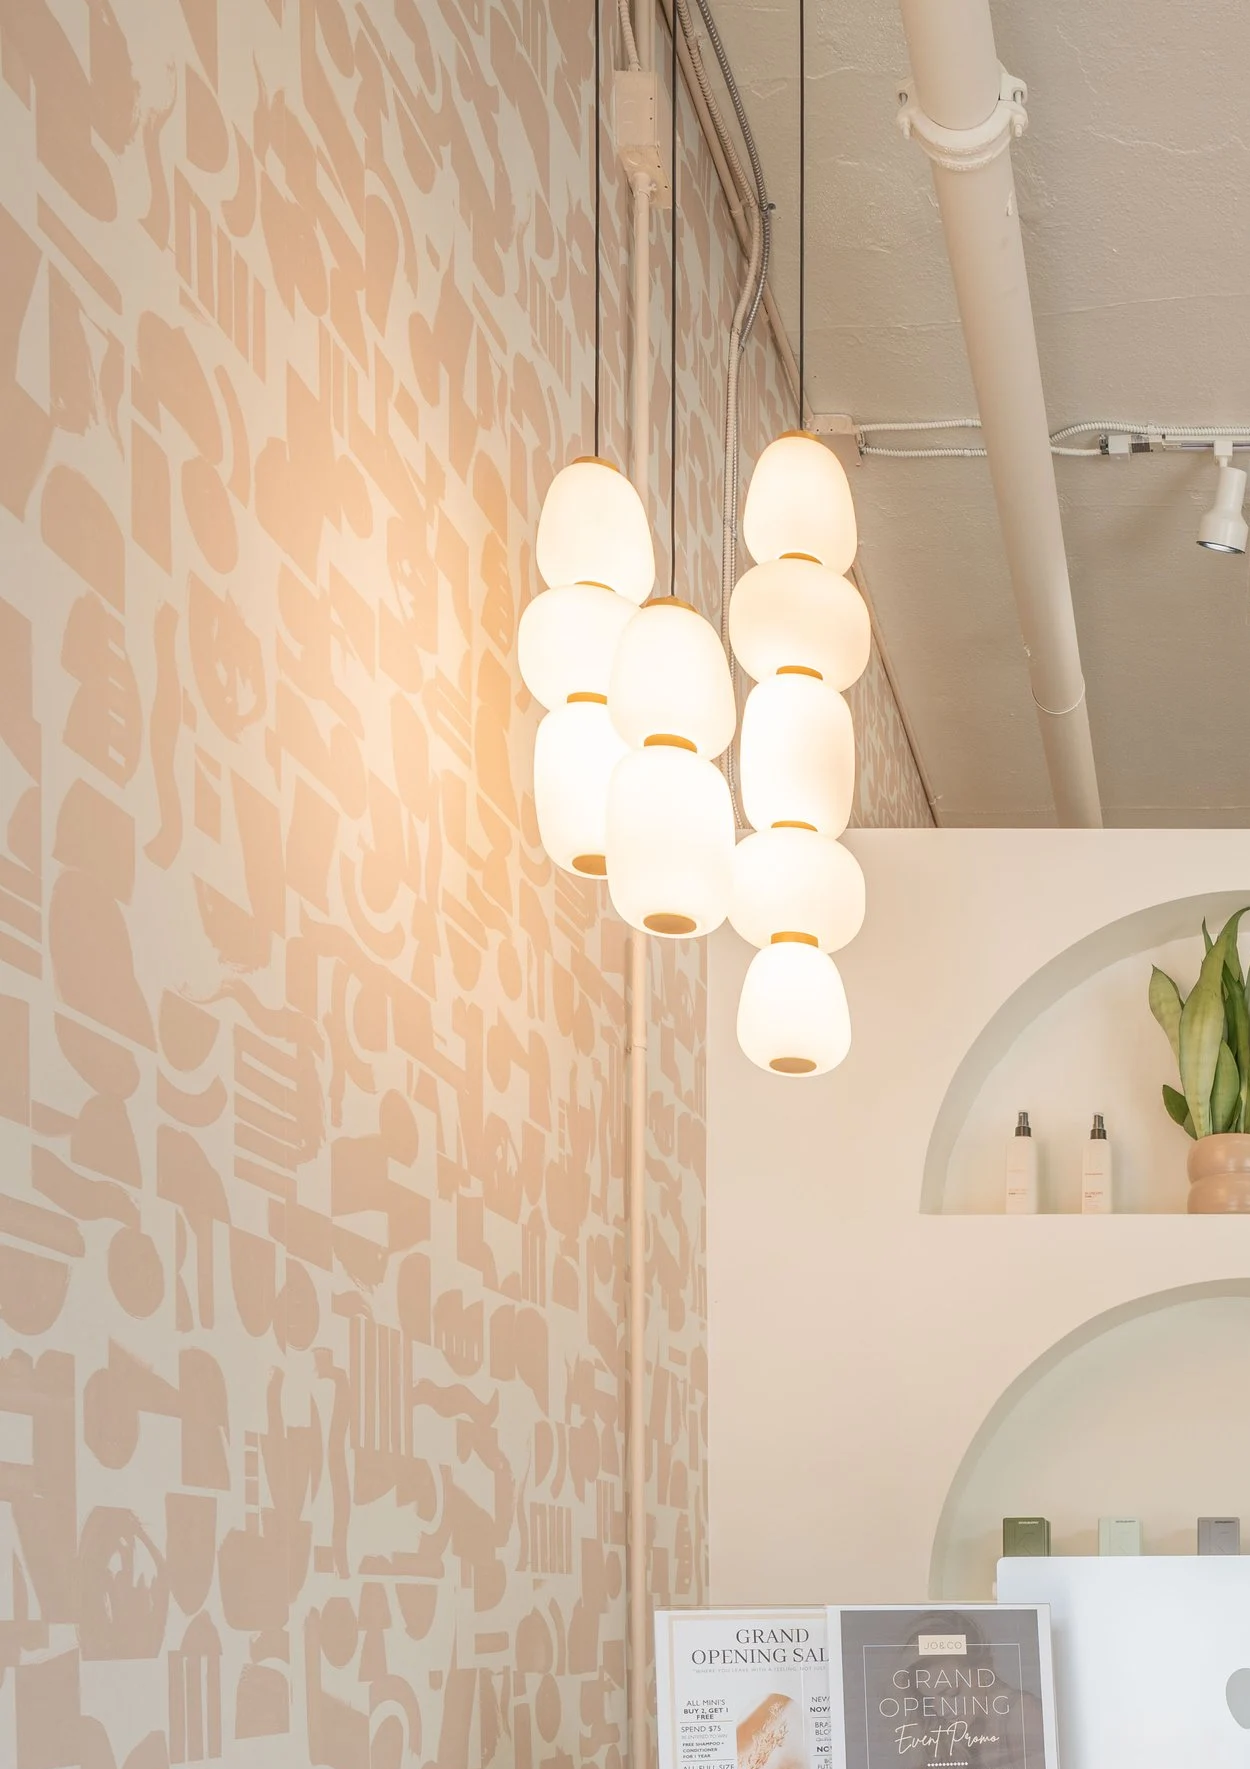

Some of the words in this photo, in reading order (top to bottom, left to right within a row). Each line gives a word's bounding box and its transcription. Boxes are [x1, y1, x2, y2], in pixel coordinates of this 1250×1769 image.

[736, 1628, 810, 1644] GRAND
[923, 1641, 963, 1650] JO&CO
[691, 1648, 787, 1665] OPENING
[792, 1647, 830, 1662] SAL
[892, 1668, 996, 1690] GRAND
[879, 1695, 1010, 1718] OPENING
[680, 1725, 707, 1733] SPEND
[894, 1722, 950, 1758] Event
[946, 1720, 1000, 1756] Promo
